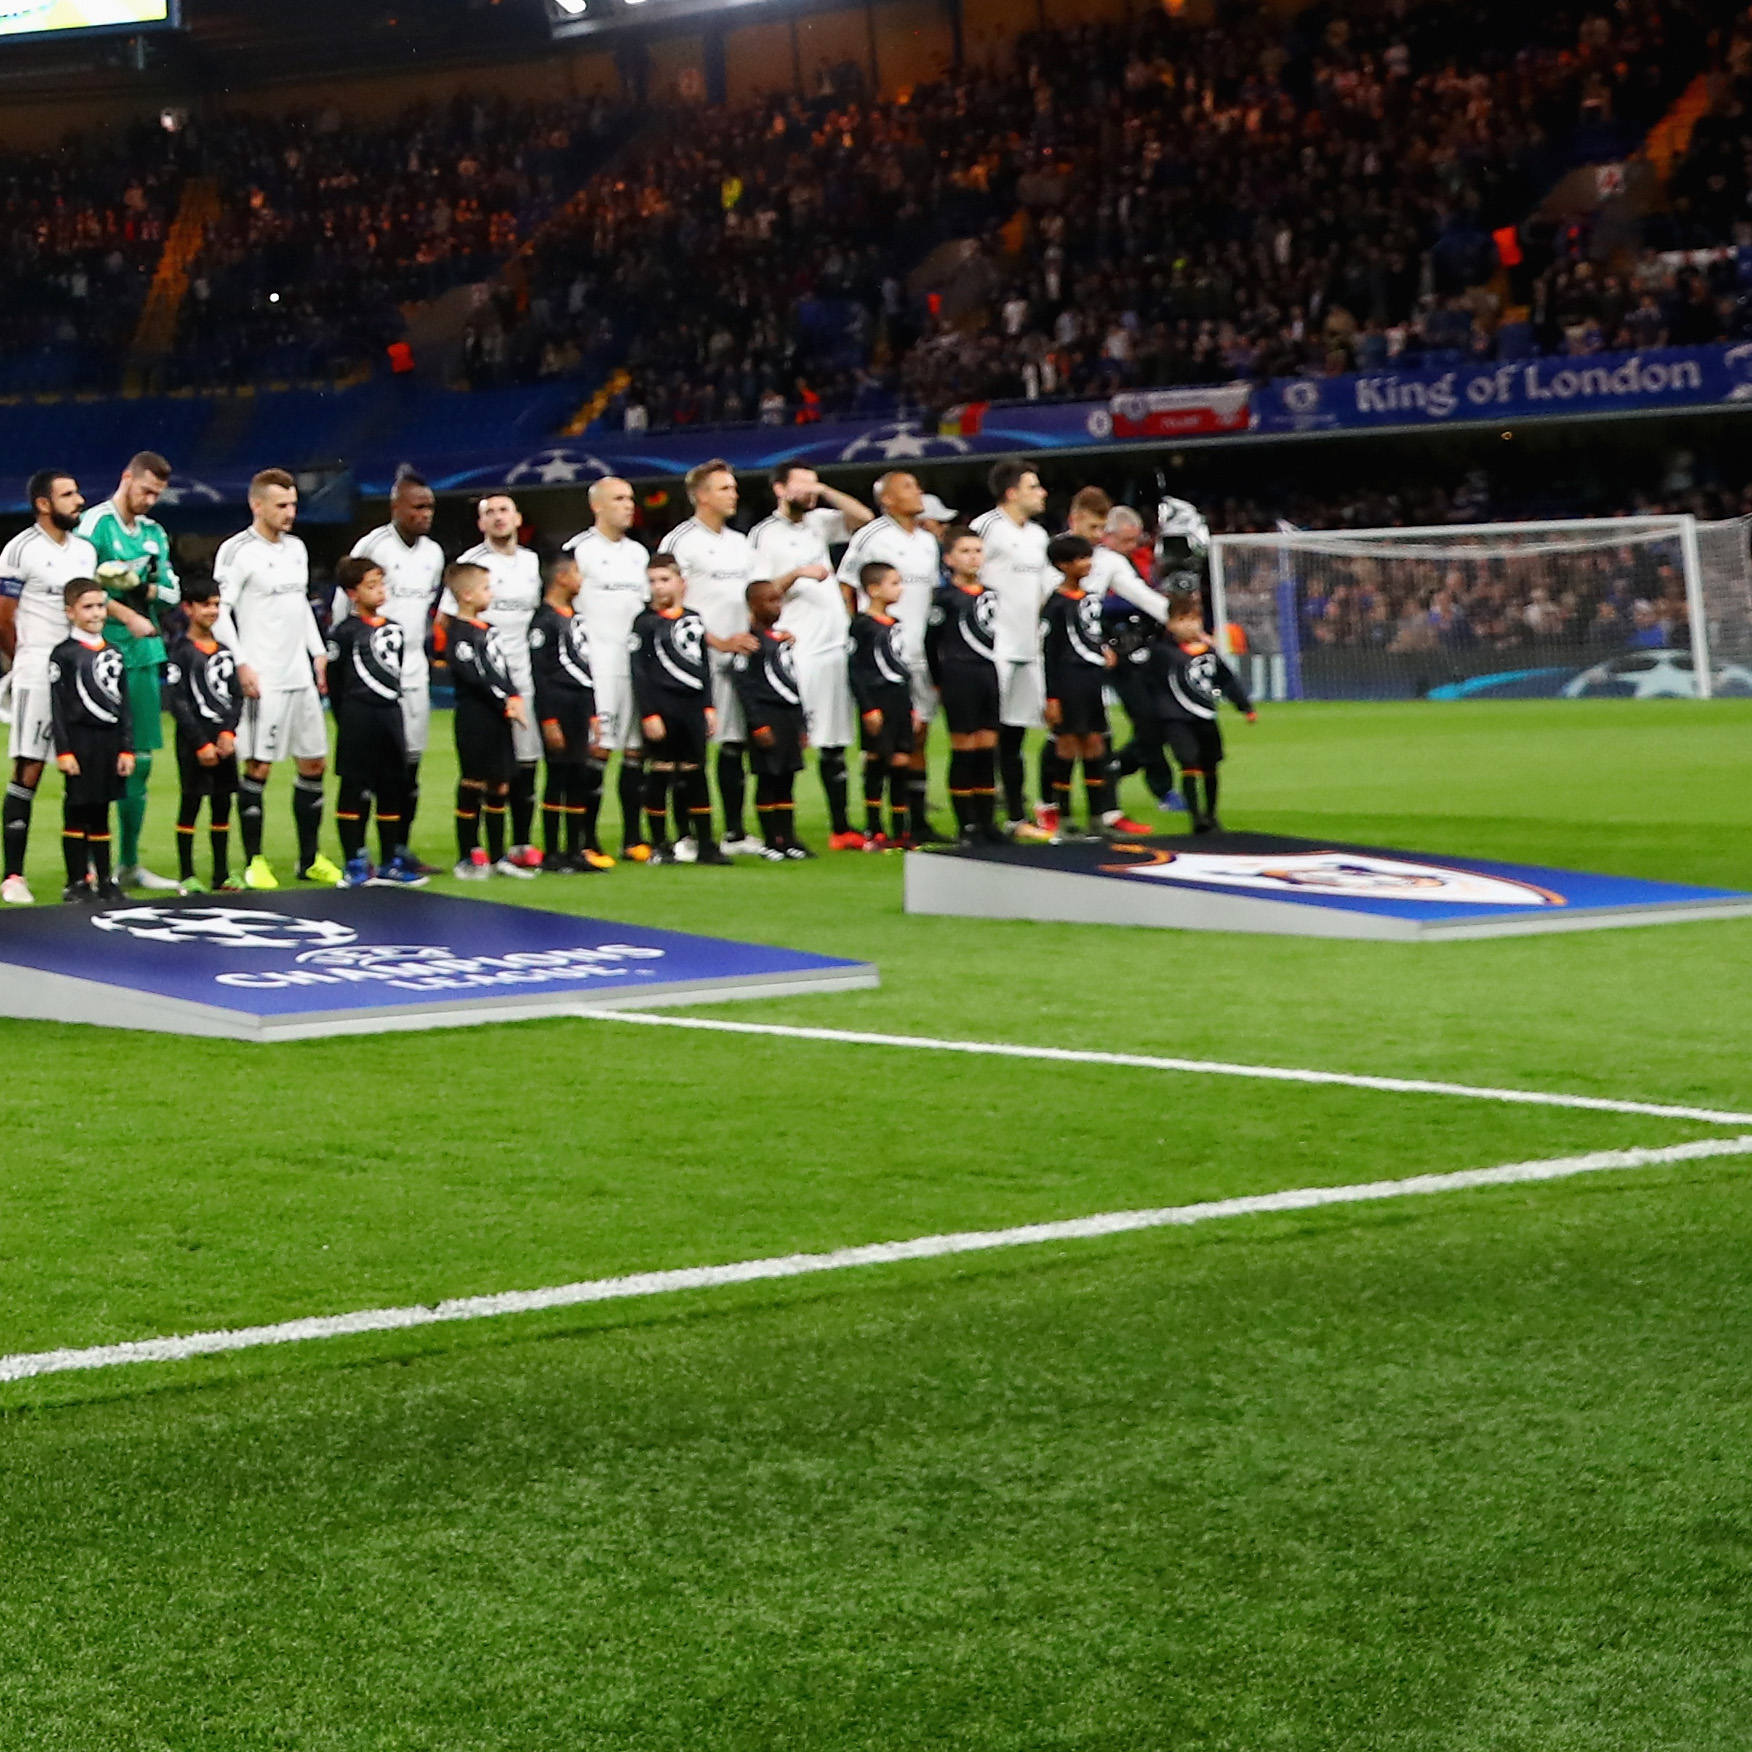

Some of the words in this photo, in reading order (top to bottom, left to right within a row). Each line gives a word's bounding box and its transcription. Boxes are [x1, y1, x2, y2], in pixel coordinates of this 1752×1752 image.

[1355, 373, 1459, 416] King
[1466, 363, 1523, 405] of
[1524, 355, 1702, 400] London
[215, 944, 666, 988] CHAMPIONS
[388, 963, 628, 991] LEAGUE
